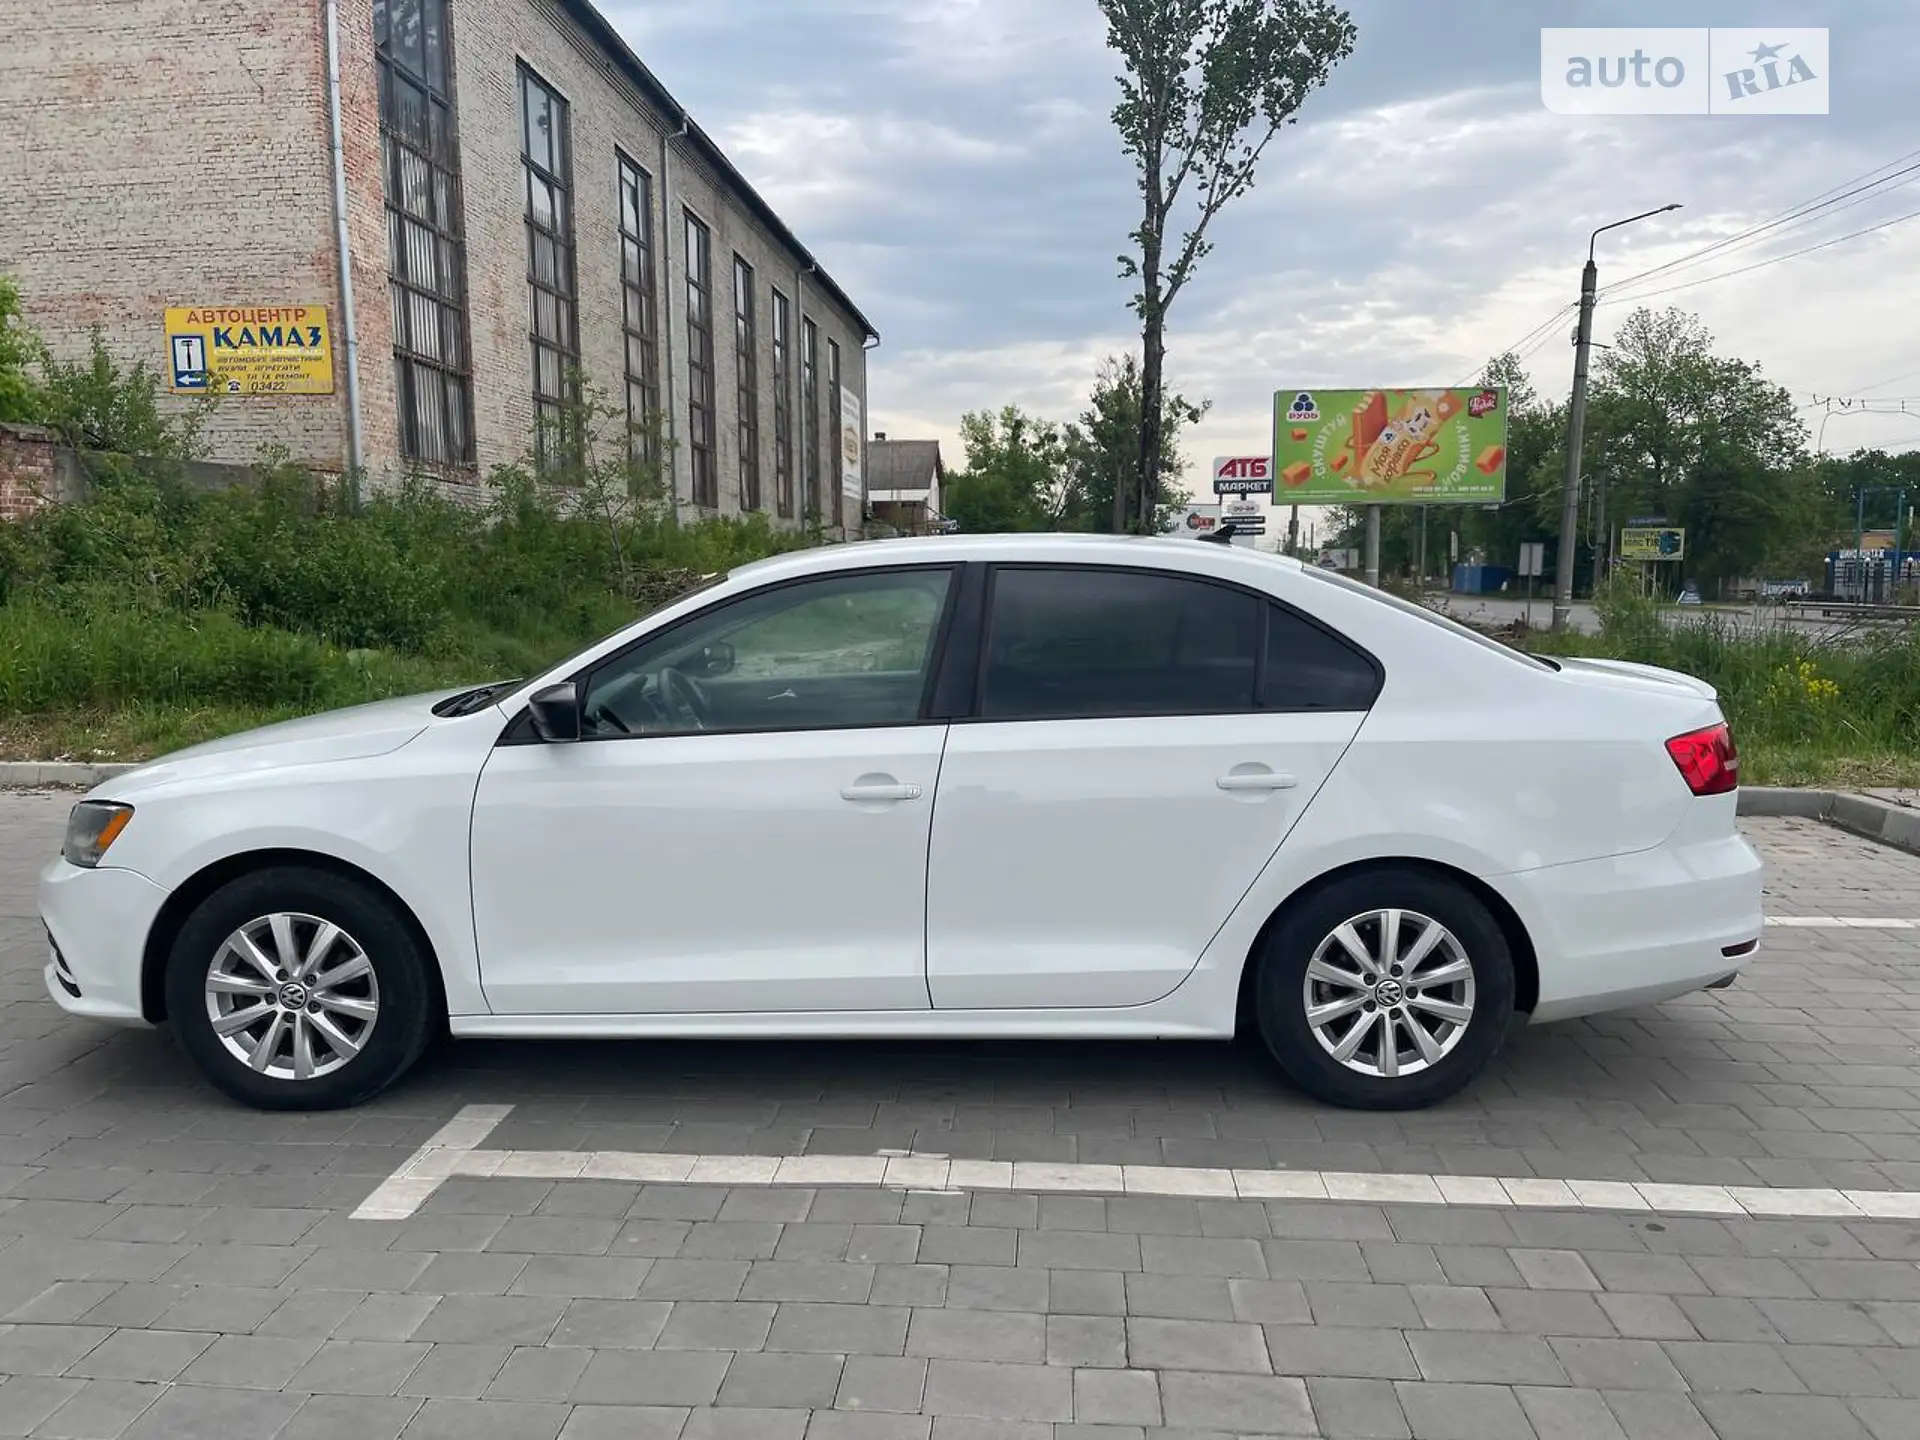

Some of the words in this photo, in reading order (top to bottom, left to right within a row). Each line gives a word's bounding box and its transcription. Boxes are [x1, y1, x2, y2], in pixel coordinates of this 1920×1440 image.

[187, 308, 307, 325] АВТОЦЕНТР
[212, 326, 322, 349] КАМАЗ
[1219, 458, 1270, 477] АТБ
[1370, 446, 1391, 478] Моя
[1219, 482, 1269, 491] МАРКЕТ
